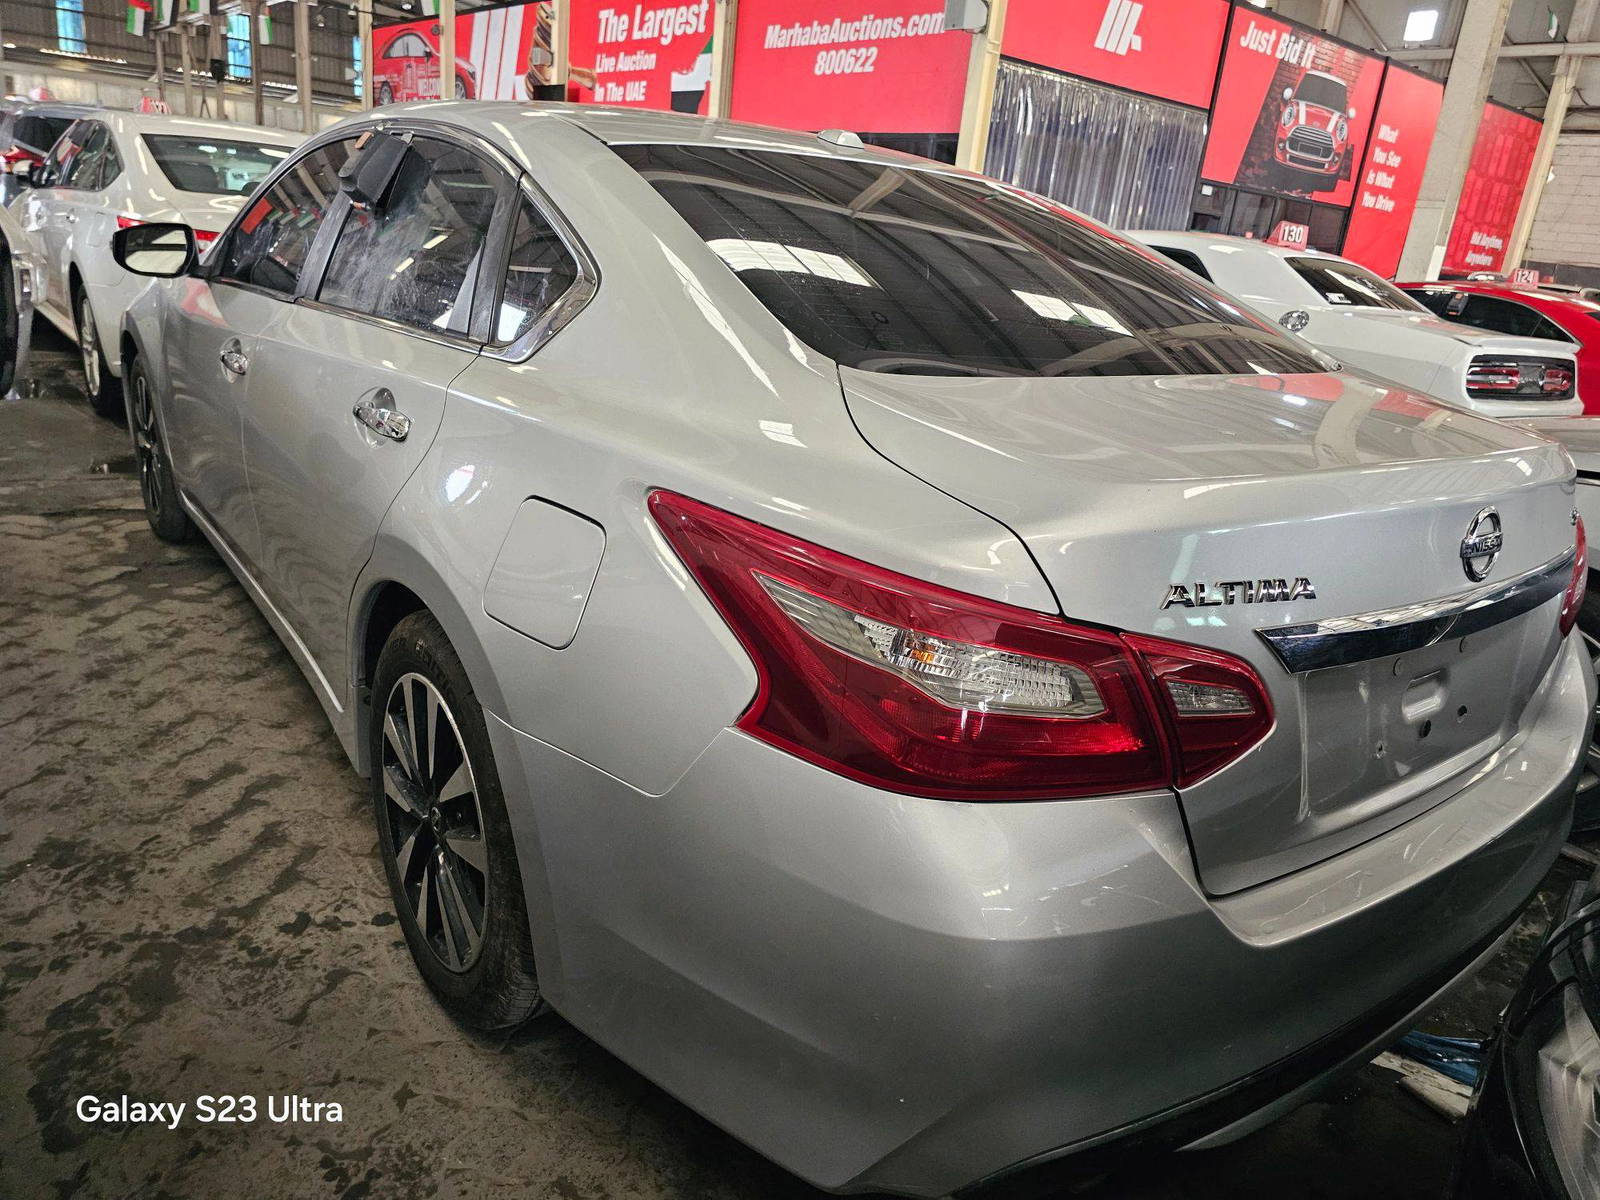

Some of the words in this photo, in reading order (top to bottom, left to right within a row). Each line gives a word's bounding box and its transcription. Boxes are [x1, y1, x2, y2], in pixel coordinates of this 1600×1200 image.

[598, 8, 629, 43] The
[632, 0, 709, 45] Largest
[764, 12, 945, 49] MarhabaAuctions.com
[1240, 20, 1277, 56] Just
[1275, 31, 1304, 64] Bid
[1301, 42, 1316, 69] It
[596, 53, 616, 73] Live
[616, 50, 656, 71] Auction
[814, 47, 878, 75] 800622
[595, 83, 605, 102] In
[606, 82, 624, 102] The
[625, 80, 647, 101] UAE
[1378, 124, 1399, 144] What
[1373, 146, 1388, 164] You
[1386, 150, 1402, 168] See
[1375, 171, 1395, 188] What
[1362, 191, 1377, 208] You
[1375, 193, 1395, 212] Drive
[1283, 225, 1303, 243] 130
[1516, 271, 1534, 284] 124
[1162, 577, 1316, 610] ALTIMA
